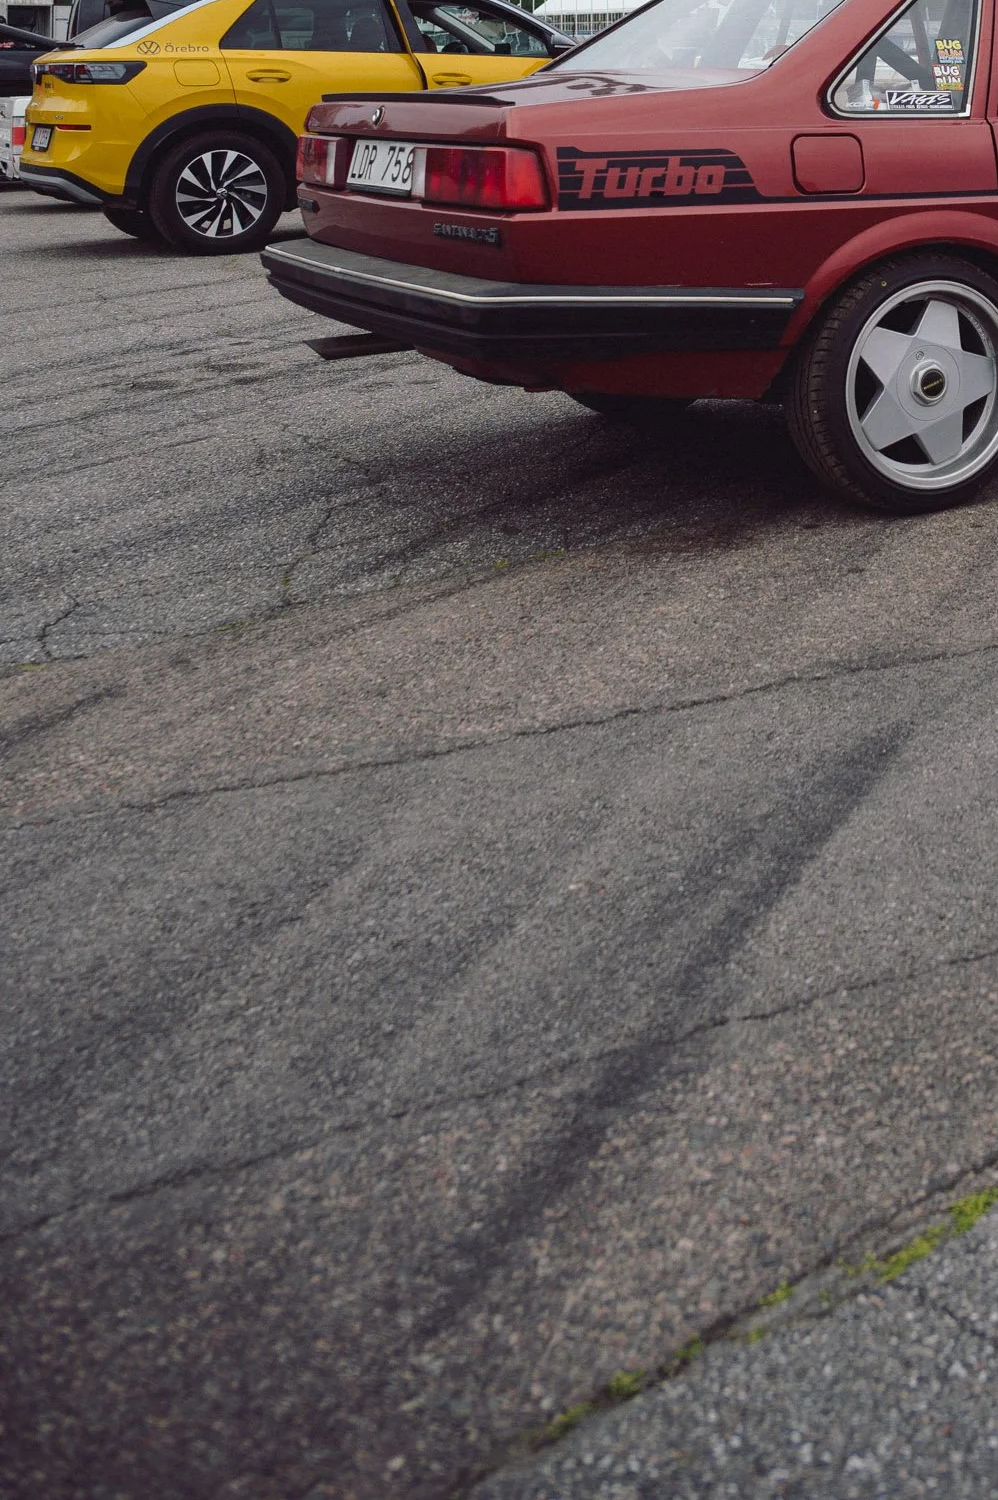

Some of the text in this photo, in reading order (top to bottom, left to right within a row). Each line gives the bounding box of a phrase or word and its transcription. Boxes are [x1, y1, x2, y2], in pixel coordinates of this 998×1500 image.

[164, 42, 209, 53] Örebro
[936, 39, 961, 50] BUG
[933, 65, 959, 76] BUG
[350, 144, 415, 184] LDR 758
[574, 156, 725, 199] Turbo
